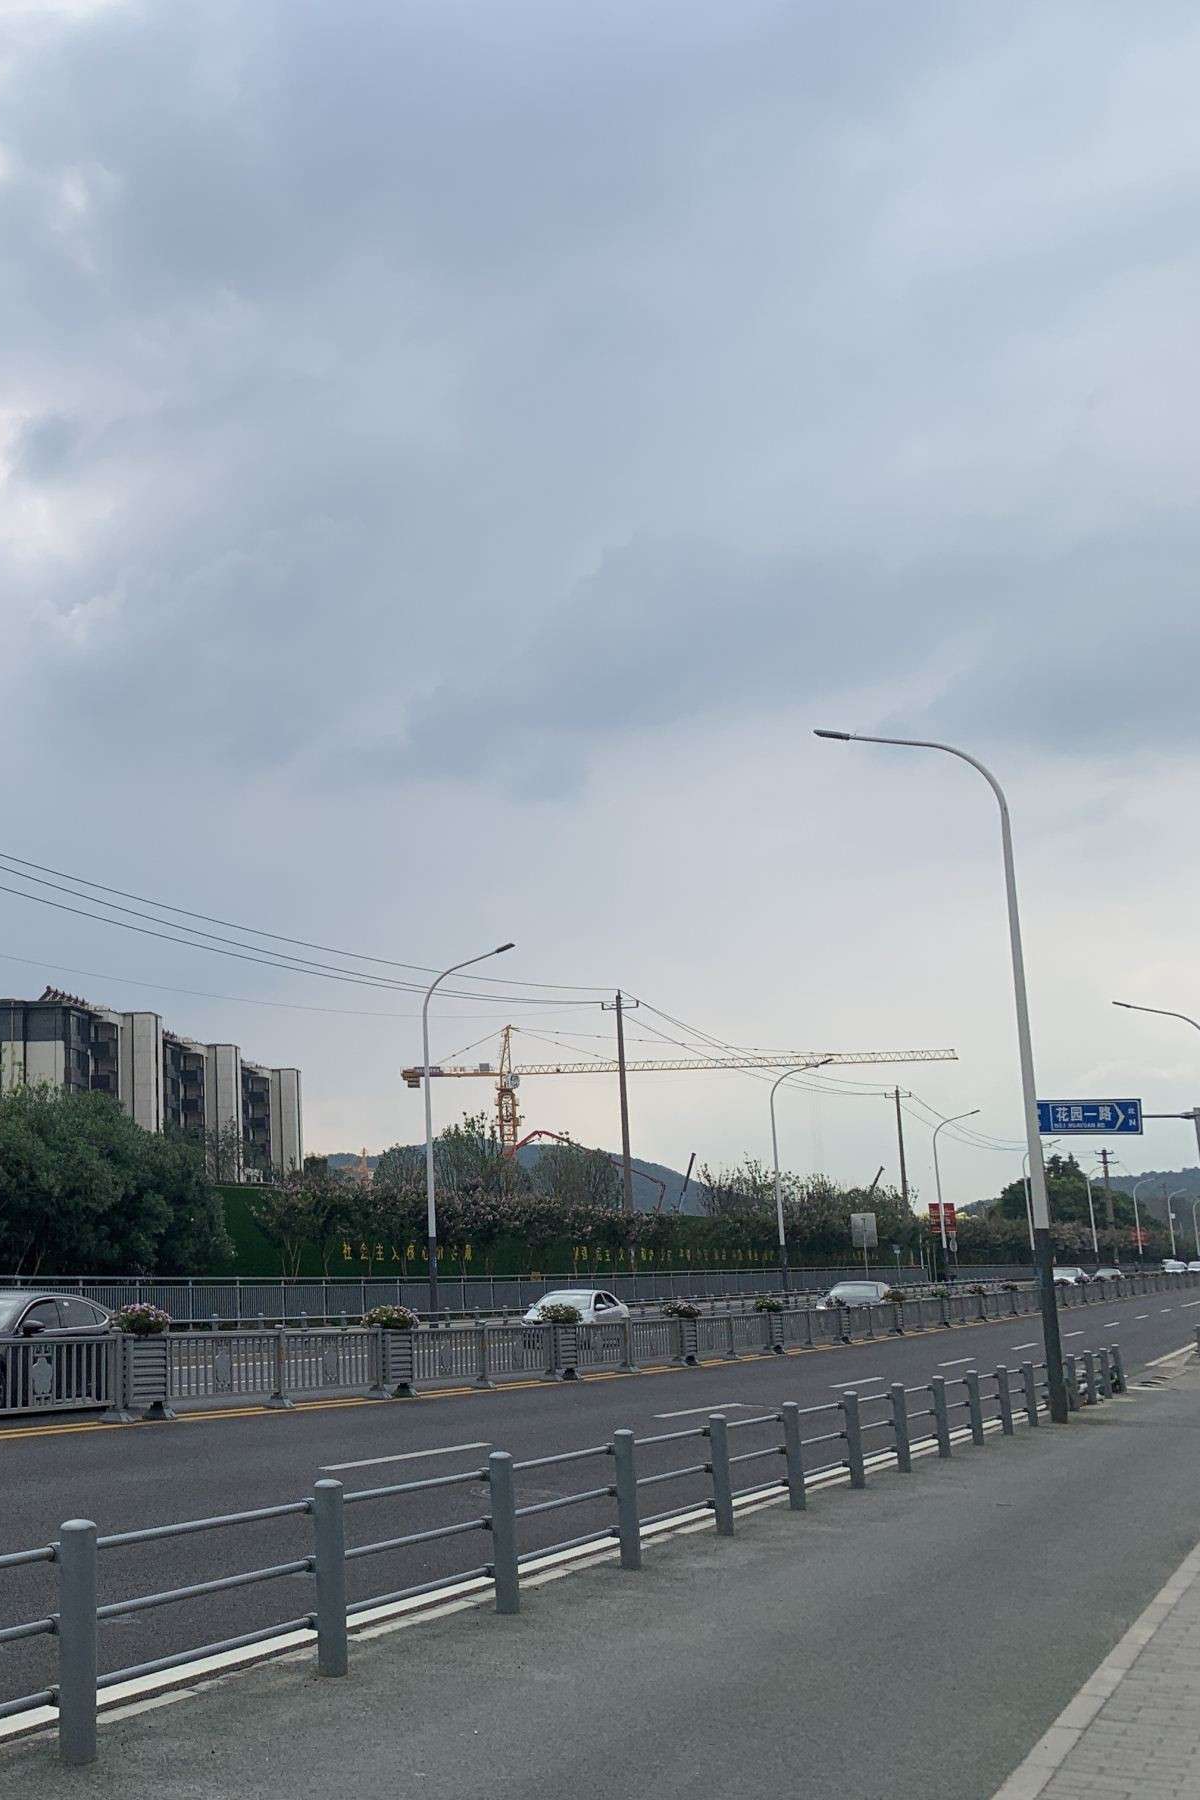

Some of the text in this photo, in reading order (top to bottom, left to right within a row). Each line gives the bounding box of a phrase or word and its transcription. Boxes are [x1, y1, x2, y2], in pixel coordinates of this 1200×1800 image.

[1055, 1106, 1112, 1122] 花园一路
[1128, 1118, 1137, 1127] N
